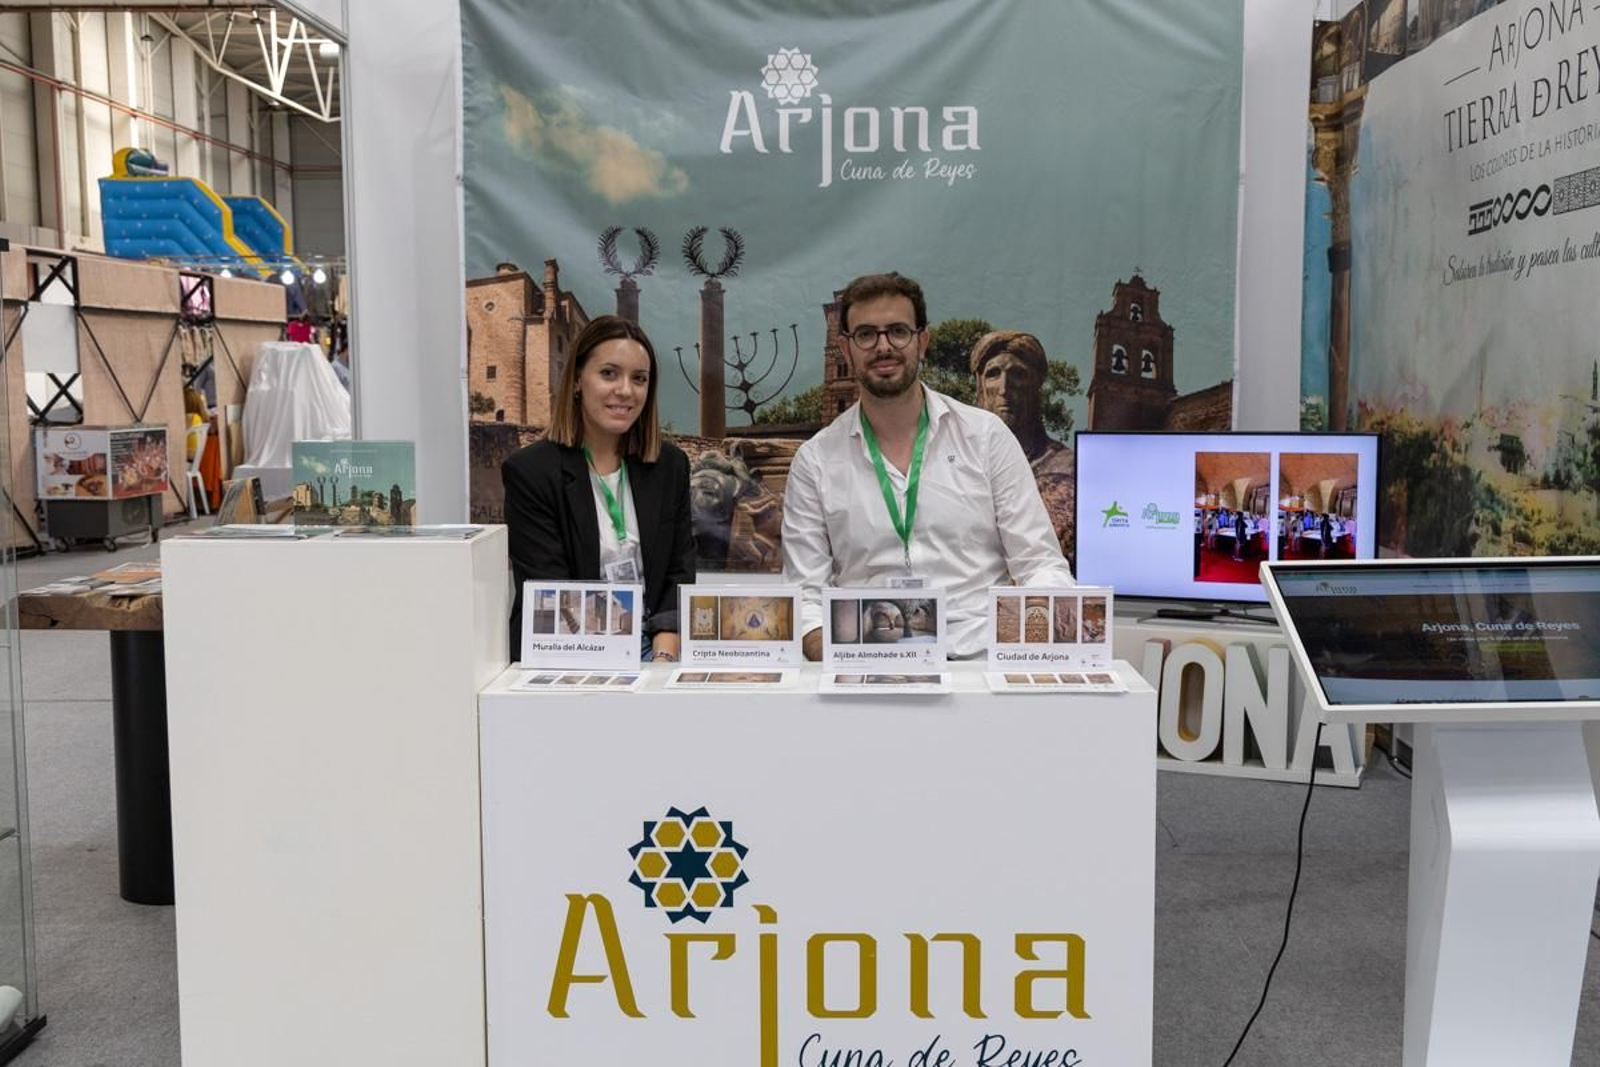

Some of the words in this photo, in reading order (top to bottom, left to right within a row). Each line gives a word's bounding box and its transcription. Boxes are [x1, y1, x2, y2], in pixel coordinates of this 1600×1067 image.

[1488, 0, 1584, 72] ARJONA
[1444, 80, 1521, 153] TIERRA
[719, 90, 982, 187] Arjona
[840, 159, 886, 181] Cuna
[892, 160, 915, 179] de
[923, 157, 977, 186] Reyes
[1469, 162, 1485, 181] LOS
[1519, 142, 1535, 162] DE
[1538, 138, 1551, 158] LA
[1514, 254, 1526, 281] y
[1421, 622, 1474, 633] Arjona,
[1475, 622, 1512, 631] Cuna
[1515, 621, 1534, 631] de
[1537, 621, 1580, 632] Reyes
[532, 642, 562, 652] Muralla
[563, 643, 576, 652] del
[576, 642, 605, 652] Alcázar
[692, 650, 717, 660] Cripta
[718, 650, 771, 658] Neobizantina
[833, 651, 855, 660] Aljibe
[858, 651, 898, 659] Almohade
[996, 653, 1027, 661] Ciudad
[1028, 653, 1040, 661] de
[1041, 653, 1070, 663] Arjona
[547, 893, 1092, 1067] Arjona
[799, 1033, 892, 1067] Cuna
[909, 1034, 956, 1067] de
